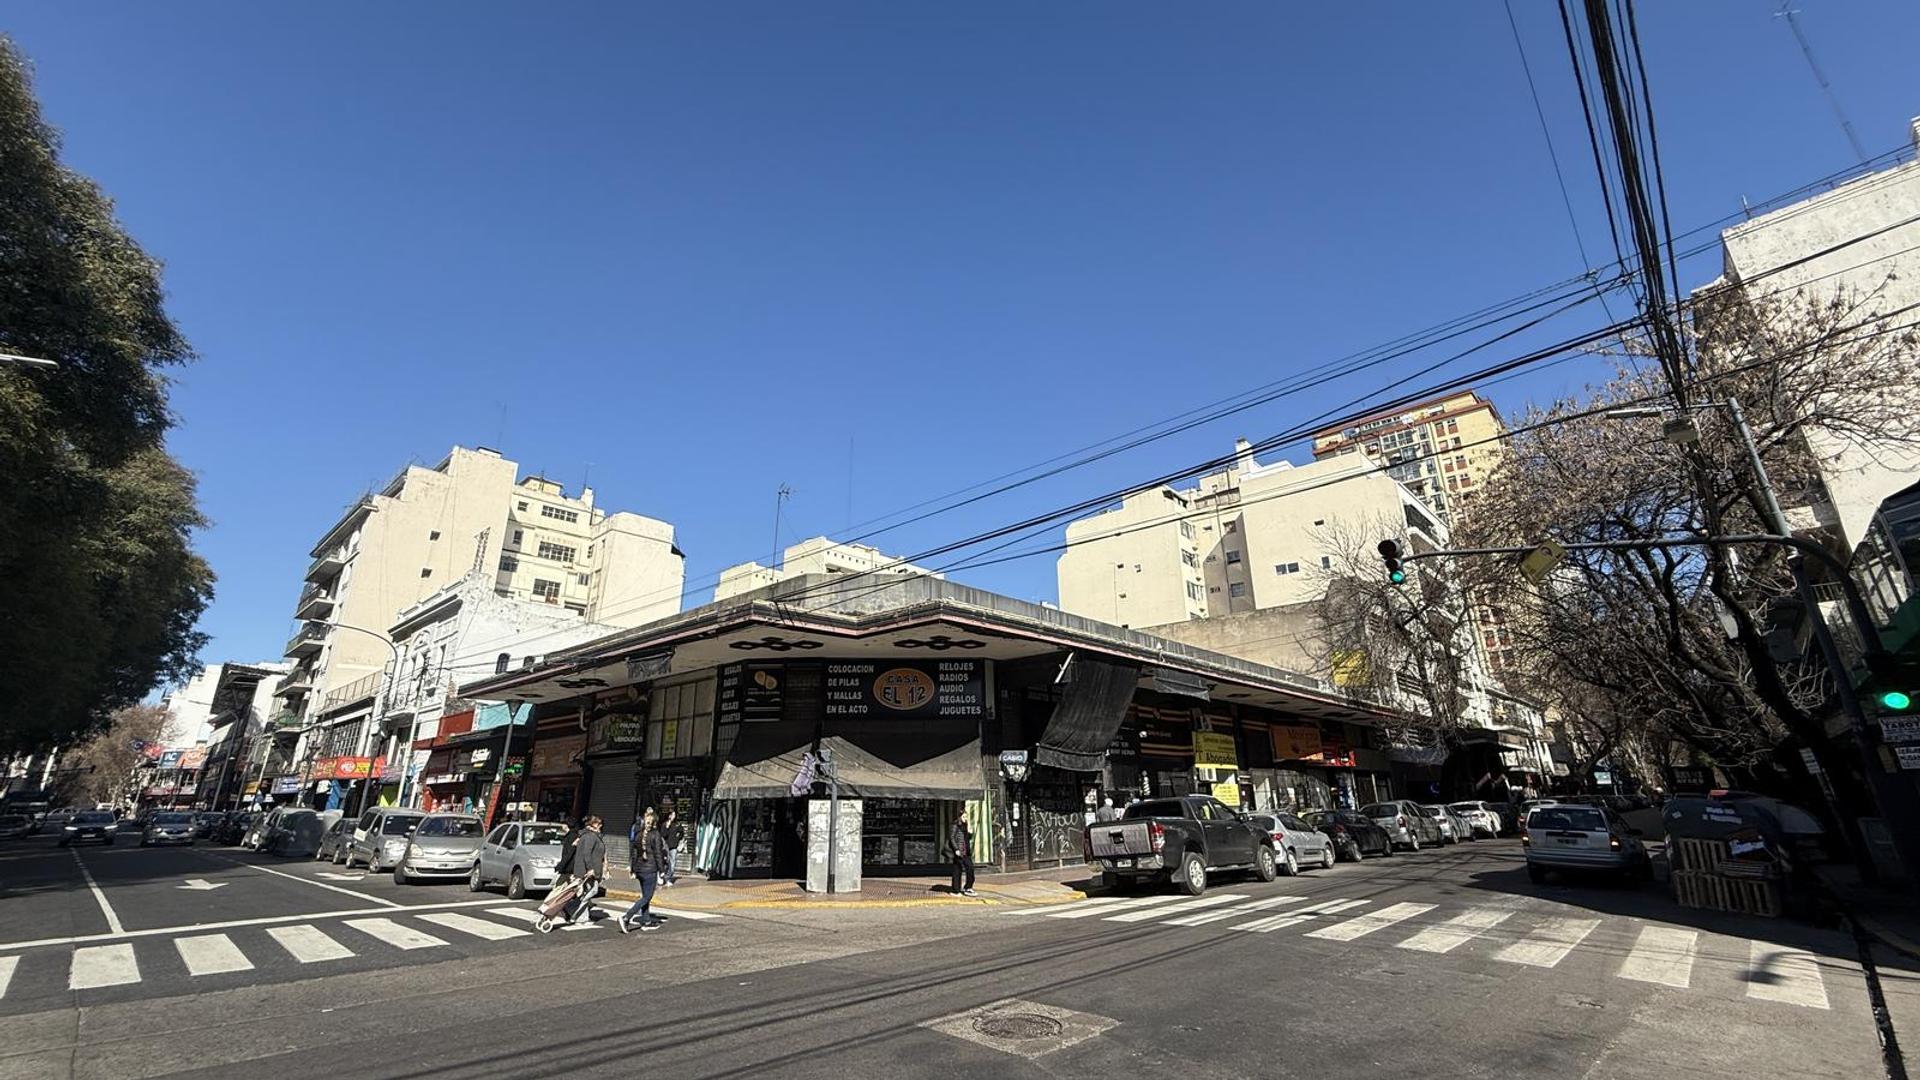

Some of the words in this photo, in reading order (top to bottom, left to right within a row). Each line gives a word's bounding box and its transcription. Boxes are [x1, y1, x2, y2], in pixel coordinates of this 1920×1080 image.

[828, 664, 875, 674] COLOCACION
[938, 662, 975, 671] RELOJES
[827, 678, 837, 687] DE
[838, 677, 860, 687] PILAS
[887, 674, 919, 684] CASA
[938, 673, 969, 682] RADIOS
[938, 683, 964, 693] AUDIO
[826, 692, 833, 700] Y
[833, 691, 863, 700] MALLAS
[883, 686, 902, 705] EL
[908, 686, 927, 705] 12
[938, 694, 977, 704] REGALOS
[826, 705, 838, 714] EN
[839, 705, 848, 714] EL
[848, 704, 869, 714] ACTO
[938, 705, 983, 716] JUGUETES
